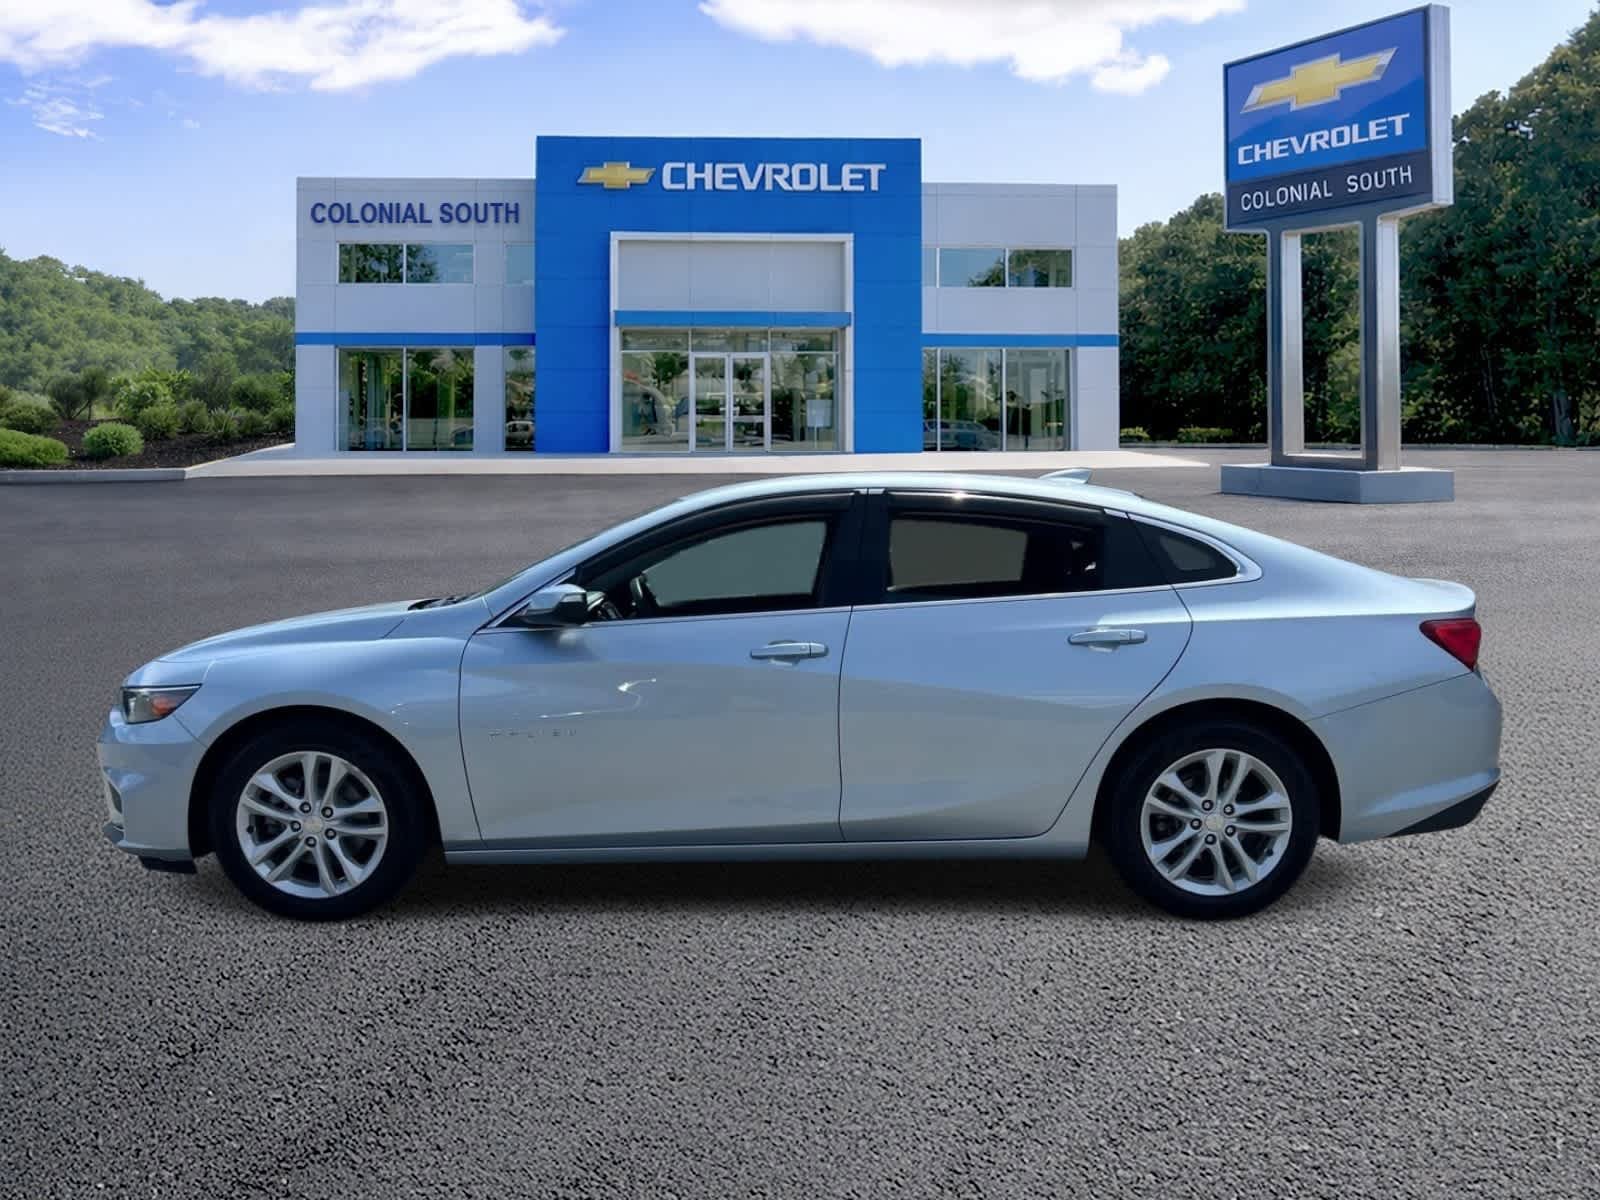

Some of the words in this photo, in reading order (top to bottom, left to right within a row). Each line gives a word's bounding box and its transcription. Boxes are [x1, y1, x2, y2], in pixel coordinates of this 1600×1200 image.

[1237, 113, 1410, 165] CHEVROLET
[661, 161, 887, 193] CHEVROLET
[1240, 180, 1333, 211] COLONIAL
[1346, 165, 1413, 194] SOUTH
[310, 202, 432, 225] COLONIAL
[439, 201, 521, 225] SOUTH
